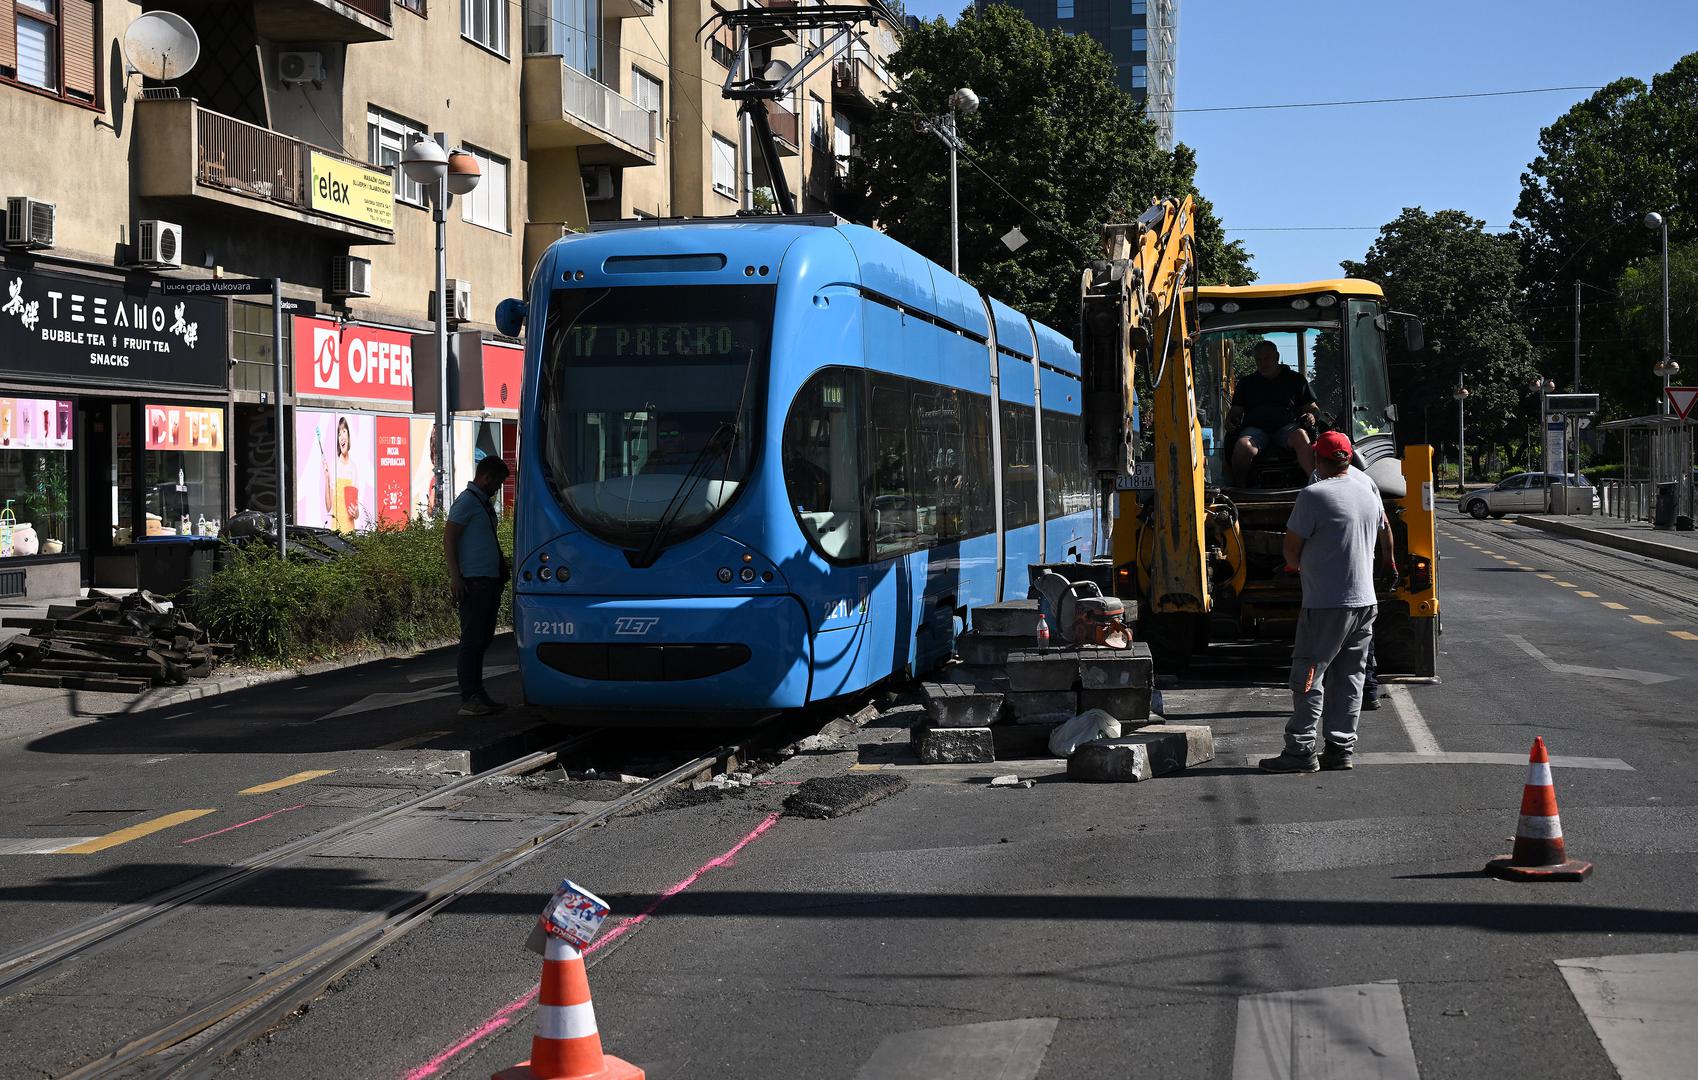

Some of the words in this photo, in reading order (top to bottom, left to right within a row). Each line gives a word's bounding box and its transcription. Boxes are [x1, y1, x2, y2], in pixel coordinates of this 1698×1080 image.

[313, 167, 350, 206] relax
[186, 282, 211, 293] grada
[212, 282, 251, 291] Vukovara
[41, 328, 84, 345] BUBBLE
[86, 333, 106, 346] TEA
[123, 337, 151, 351] FRUIT
[153, 340, 170, 353] TEA
[572, 326, 598, 357] 17
[616, 322, 733, 356] PREČKO
[90, 353, 130, 367] SNACKS
[184, 408, 222, 447] TEA
[823, 598, 854, 620] 22110
[533, 621, 574, 636] 22110
